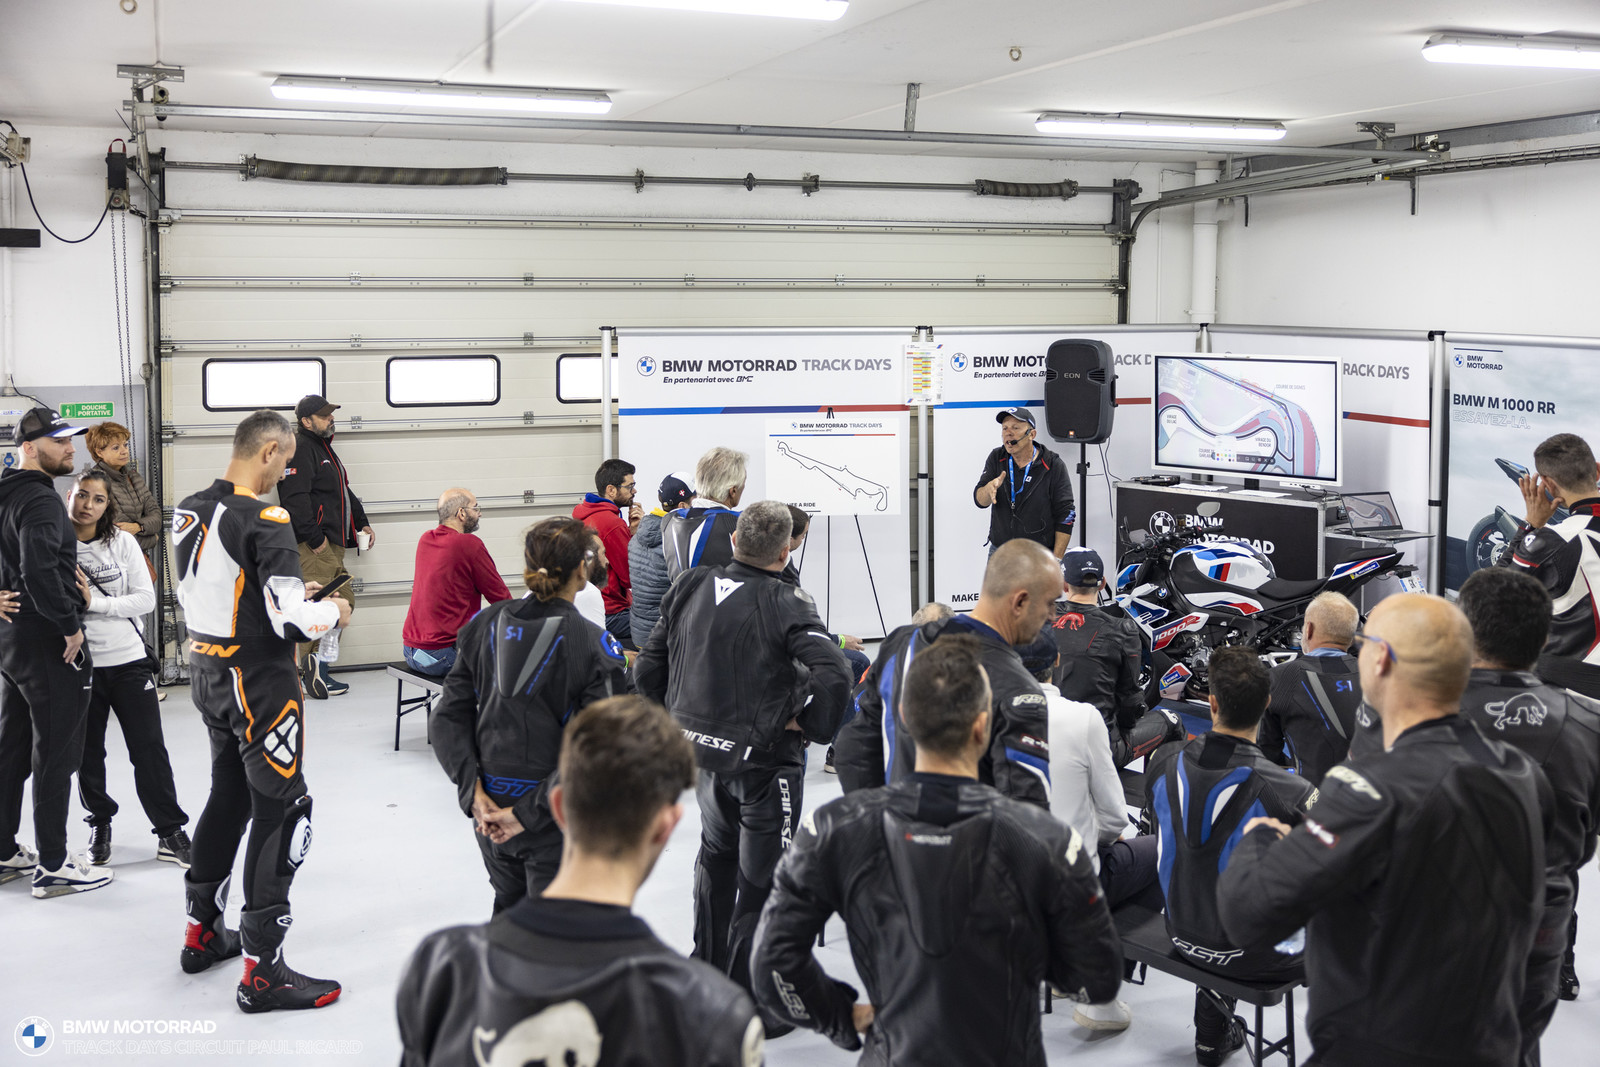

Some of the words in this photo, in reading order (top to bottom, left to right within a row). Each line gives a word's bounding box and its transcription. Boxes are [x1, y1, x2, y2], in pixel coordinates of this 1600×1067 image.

[662, 360, 703, 372] BMW
[708, 359, 797, 372] MOTORRAD
[802, 358, 852, 371] TRACK
[854, 358, 892, 370] DAYS
[973, 356, 1009, 367] BMW
[1013, 355, 1047, 367] MOT
[1114, 354, 1142, 365] ACK
[1467, 362, 1503, 370] MOTORRAD
[983, 371, 1021, 379] partenariat
[1342, 362, 1375, 377] RACK
[1377, 365, 1409, 380] DAYS
[674, 375, 716, 384] partenariat
[1453, 394, 1486, 408] BMW
[1488, 397, 1499, 409] M
[1502, 398, 1534, 413] 1000
[1537, 401, 1556, 415] RR
[1453, 409, 1531, 430] ESSAYEZ-LA.
[951, 592, 980, 603] MAKE
[504, 625, 523, 642] S-1
[1153, 622, 1187, 641] 1000
[190, 640, 241, 658] ON
[1336, 680, 1353, 692] S-1
[778, 777, 793, 849] DAINESE
